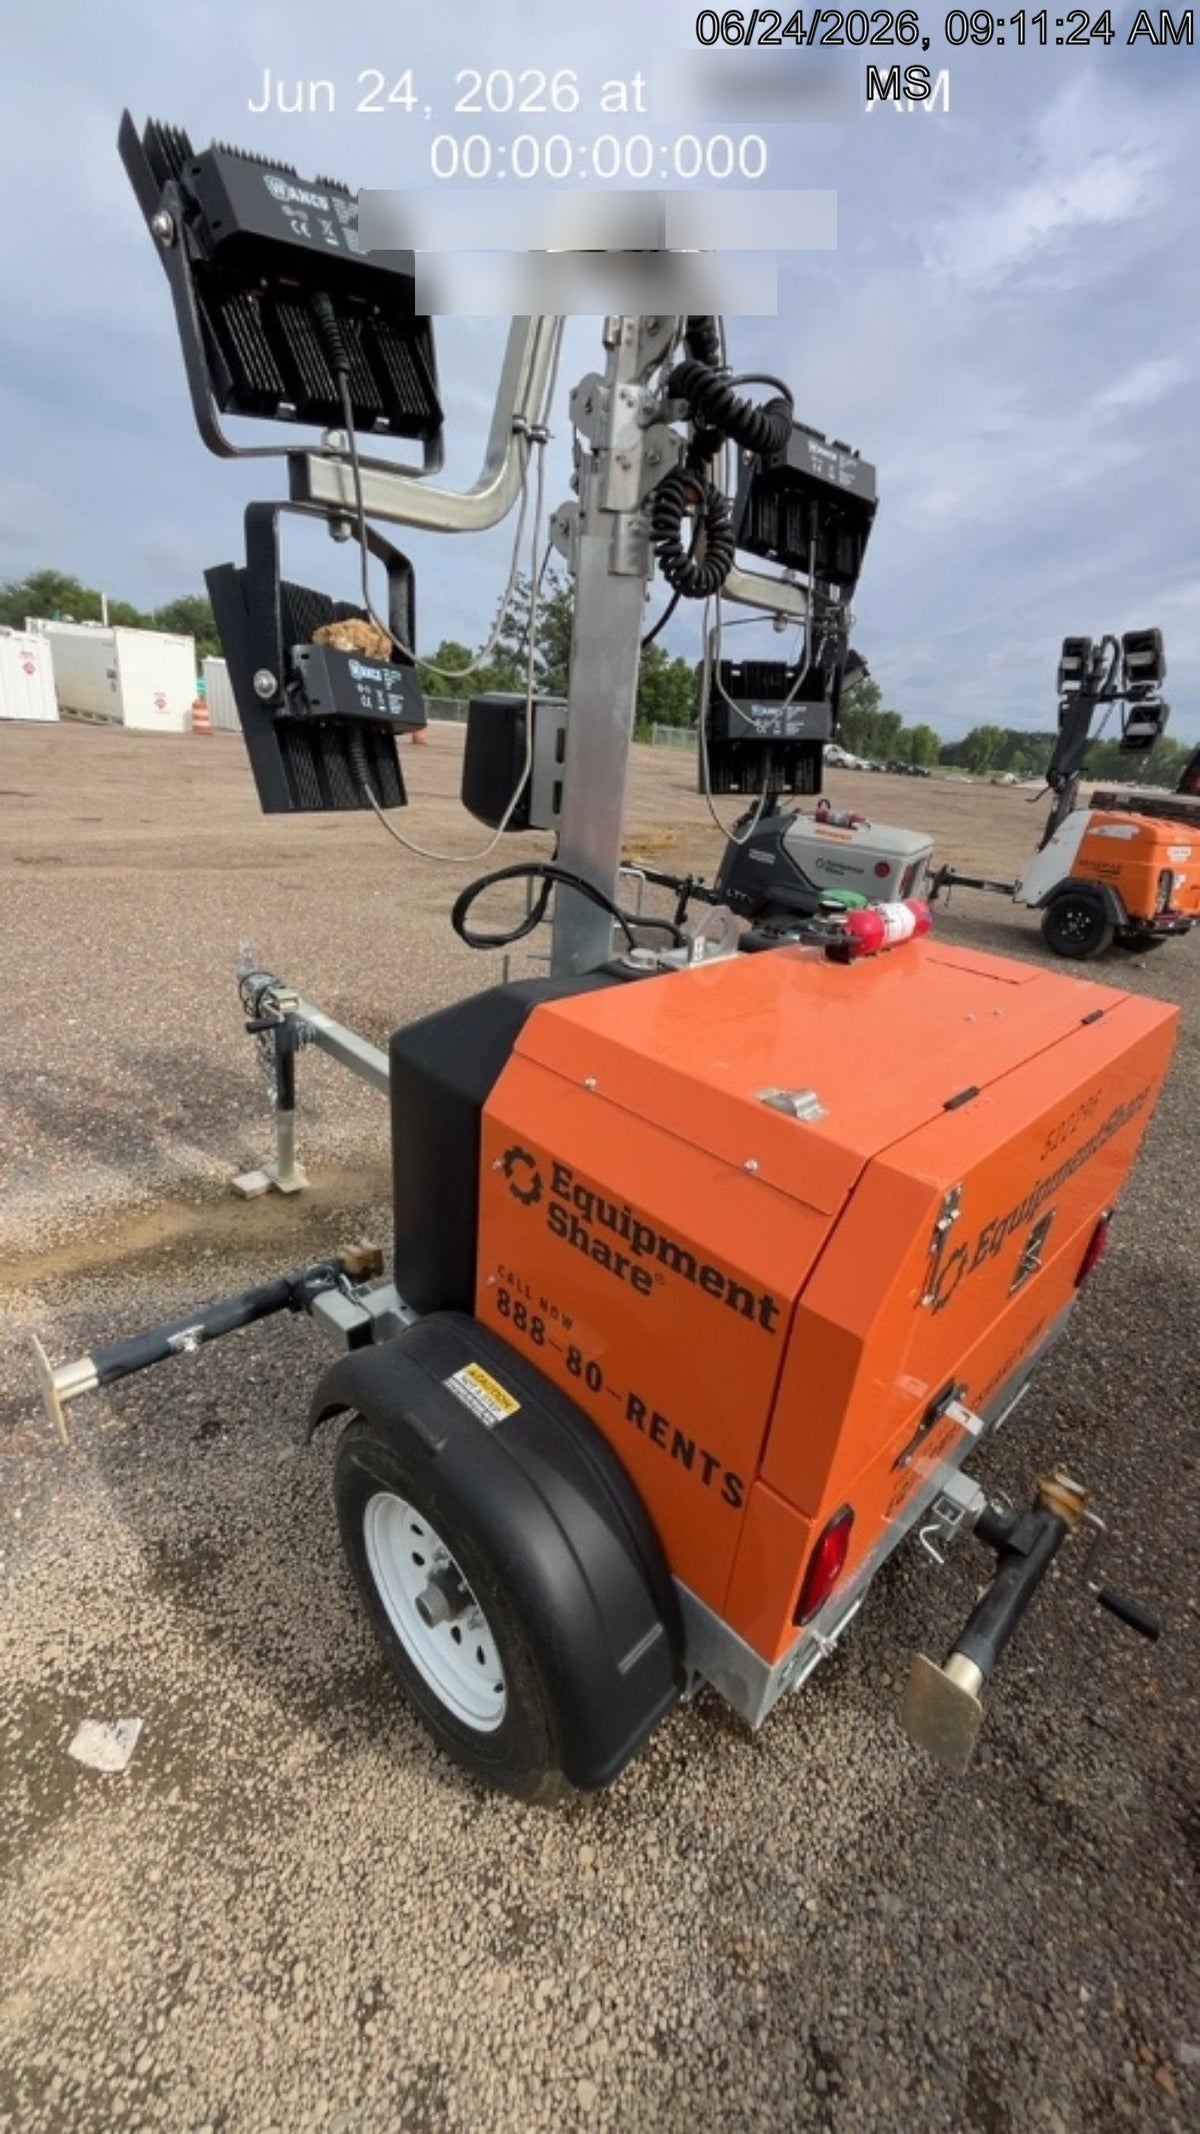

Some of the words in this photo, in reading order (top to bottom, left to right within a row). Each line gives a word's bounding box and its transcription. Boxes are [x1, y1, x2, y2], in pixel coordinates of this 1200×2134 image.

[498, 1263, 531, 1301] CALL
[539, 1296, 574, 1331] NOW
[550, 1161, 780, 1335] Equipment
[496, 1287, 746, 1509] 888-80-RENTS
